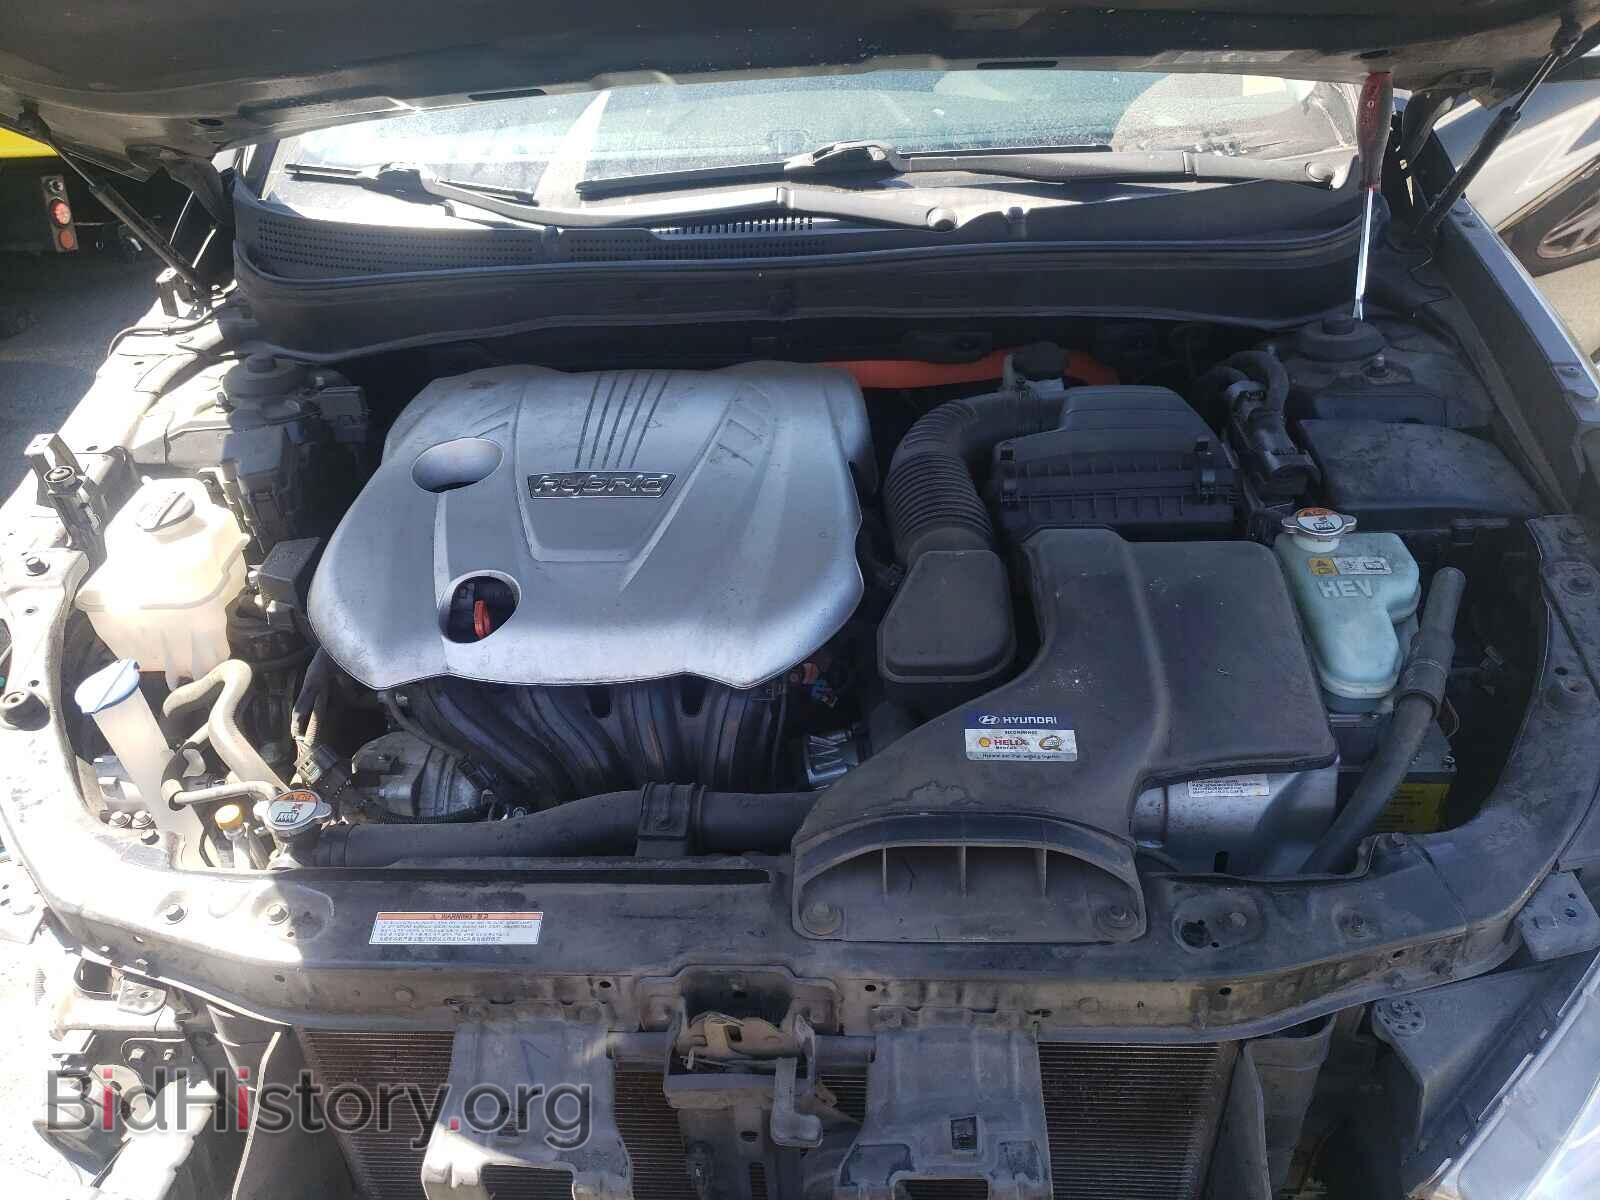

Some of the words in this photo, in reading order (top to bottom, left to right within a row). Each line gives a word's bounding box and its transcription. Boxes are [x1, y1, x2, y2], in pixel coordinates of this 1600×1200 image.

[534, 475, 667, 496] hybrid
[1317, 579, 1373, 598] HEV
[1003, 716, 1057, 724] HYUNDAI
